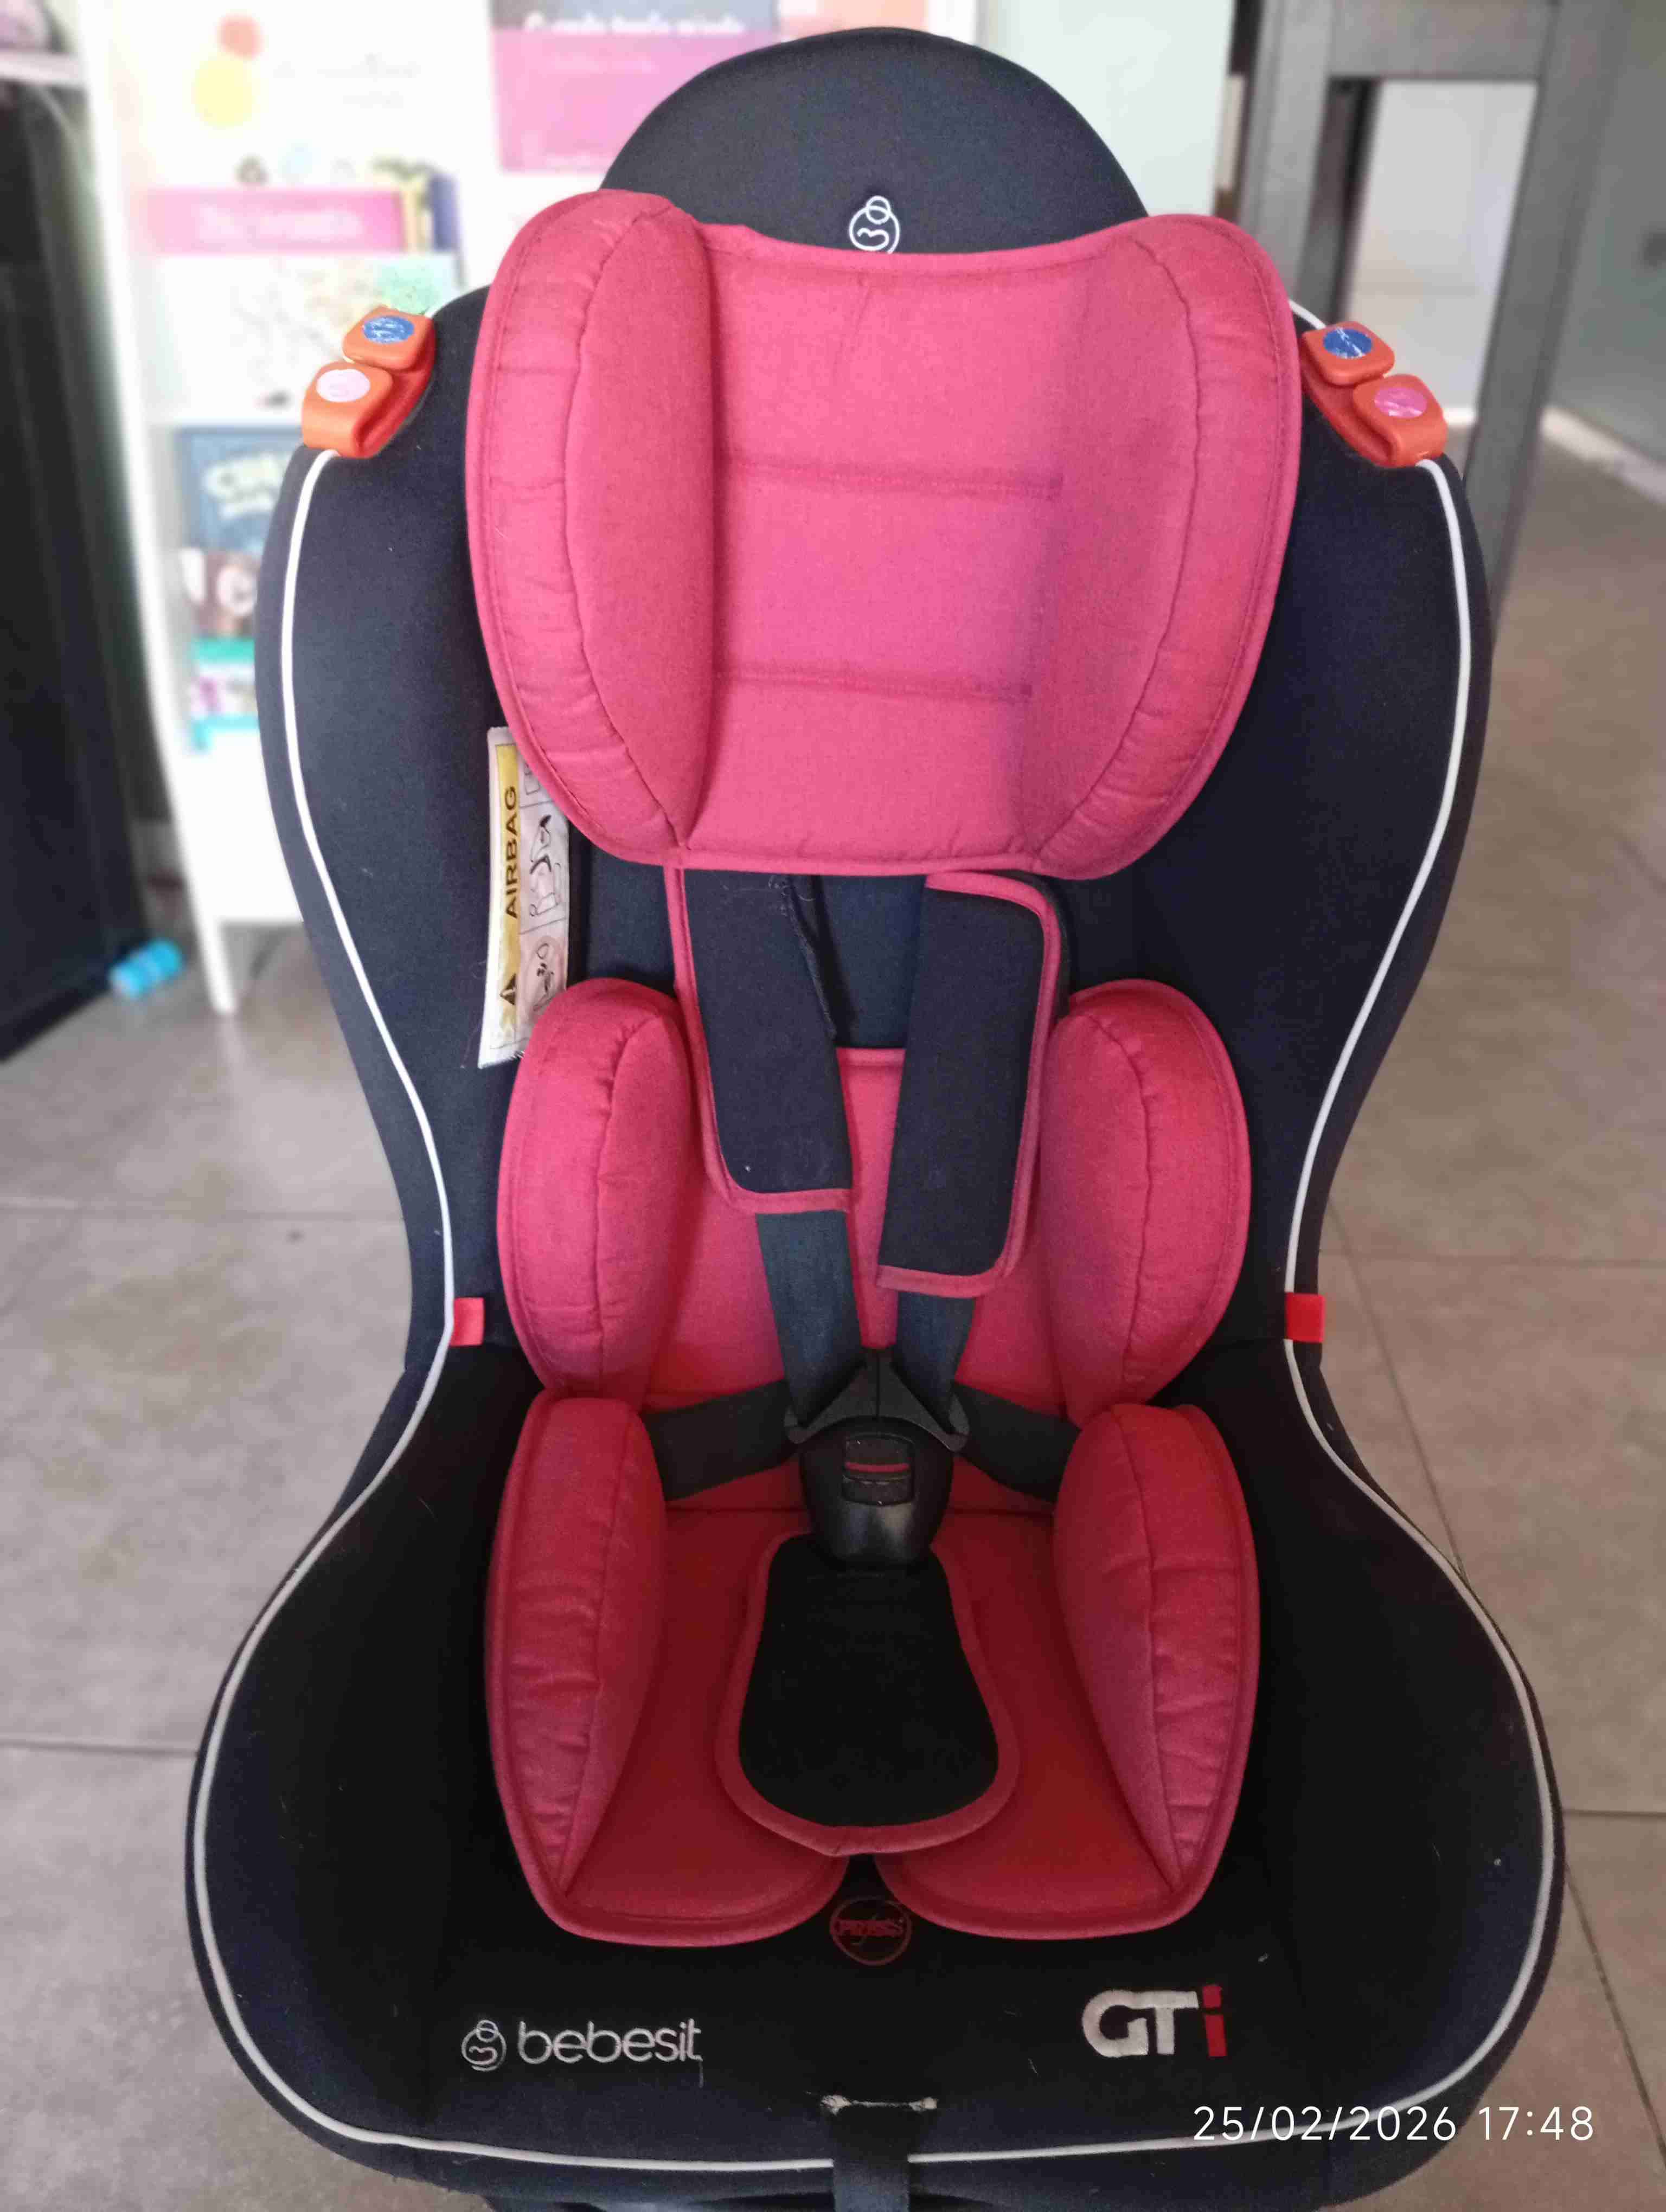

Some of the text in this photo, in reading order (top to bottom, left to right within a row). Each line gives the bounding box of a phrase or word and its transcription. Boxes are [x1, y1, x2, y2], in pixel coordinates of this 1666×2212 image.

[505, 786, 517, 918] AIRBAG
[518, 2018, 703, 2064] bebesit
[1081, 1984, 1228, 2059] GTi
